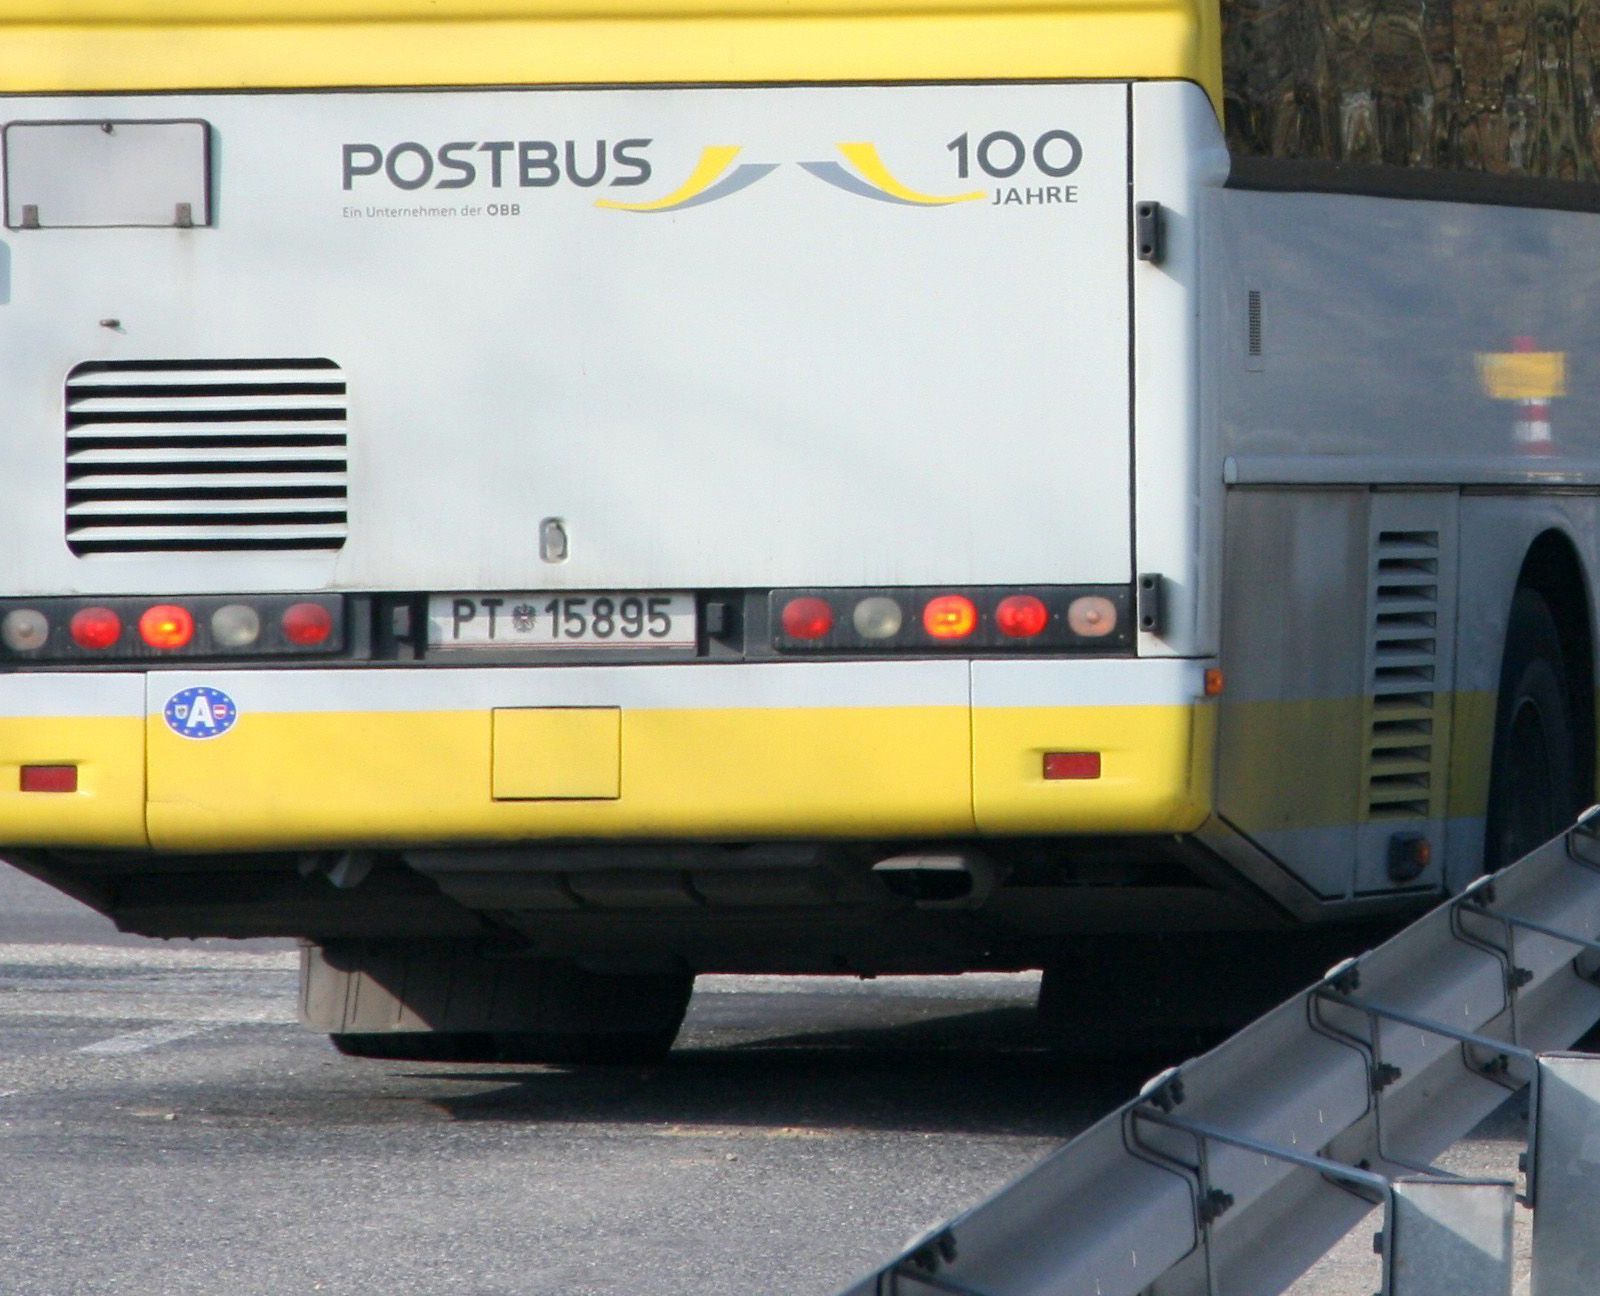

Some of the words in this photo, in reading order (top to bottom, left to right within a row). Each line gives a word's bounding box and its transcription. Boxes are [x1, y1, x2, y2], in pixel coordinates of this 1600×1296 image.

[342, 138, 654, 191] POSTBUS
[946, 129, 1083, 179] 100
[343, 206, 362, 218] Ein
[366, 204, 457, 218] Unternehmen
[460, 204, 482, 217] der
[991, 185, 1079, 205] JAHRE
[452, 597, 504, 639] PT
[545, 596, 672, 639] 15895
[186, 695, 215, 728] A
